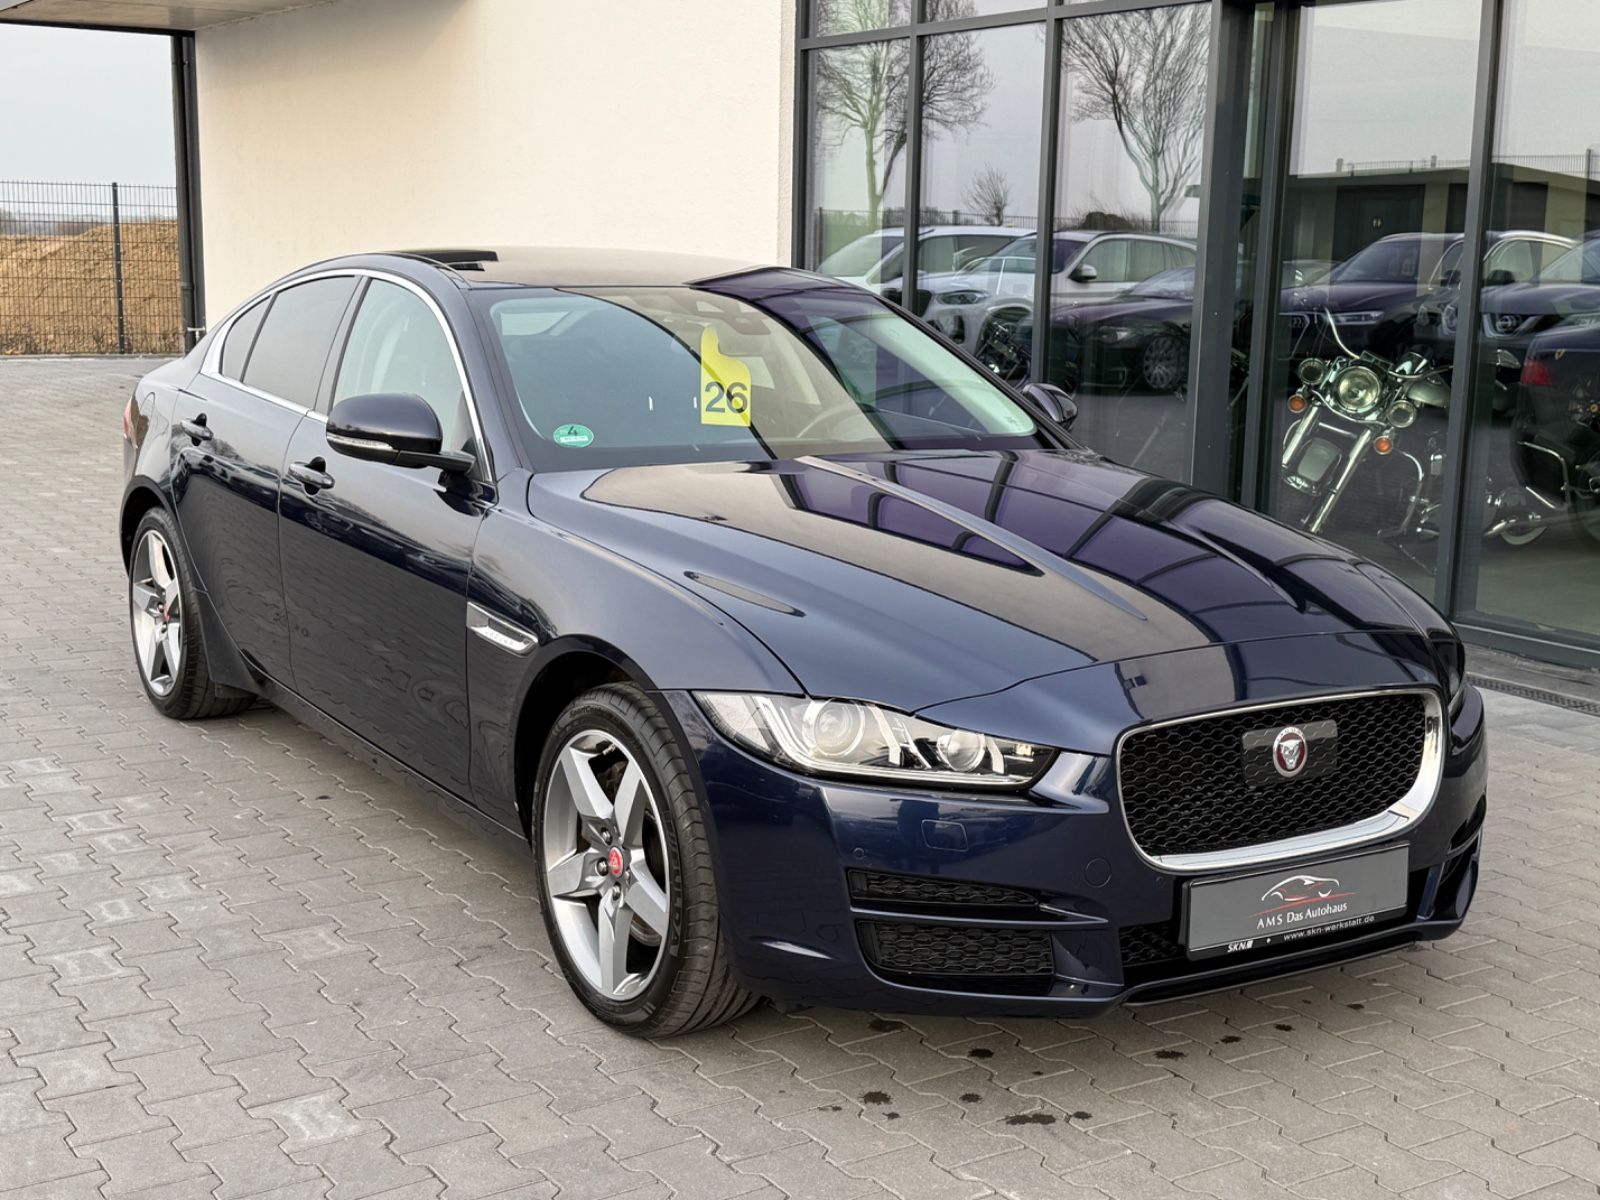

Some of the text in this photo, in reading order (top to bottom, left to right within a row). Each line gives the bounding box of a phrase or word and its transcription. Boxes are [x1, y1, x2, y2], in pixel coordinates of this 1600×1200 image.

[704, 381, 748, 414] 26
[1256, 902, 1348, 930] AMS Das Autohaus
[1283, 915, 1375, 941] www.skn-werkstatt.de
